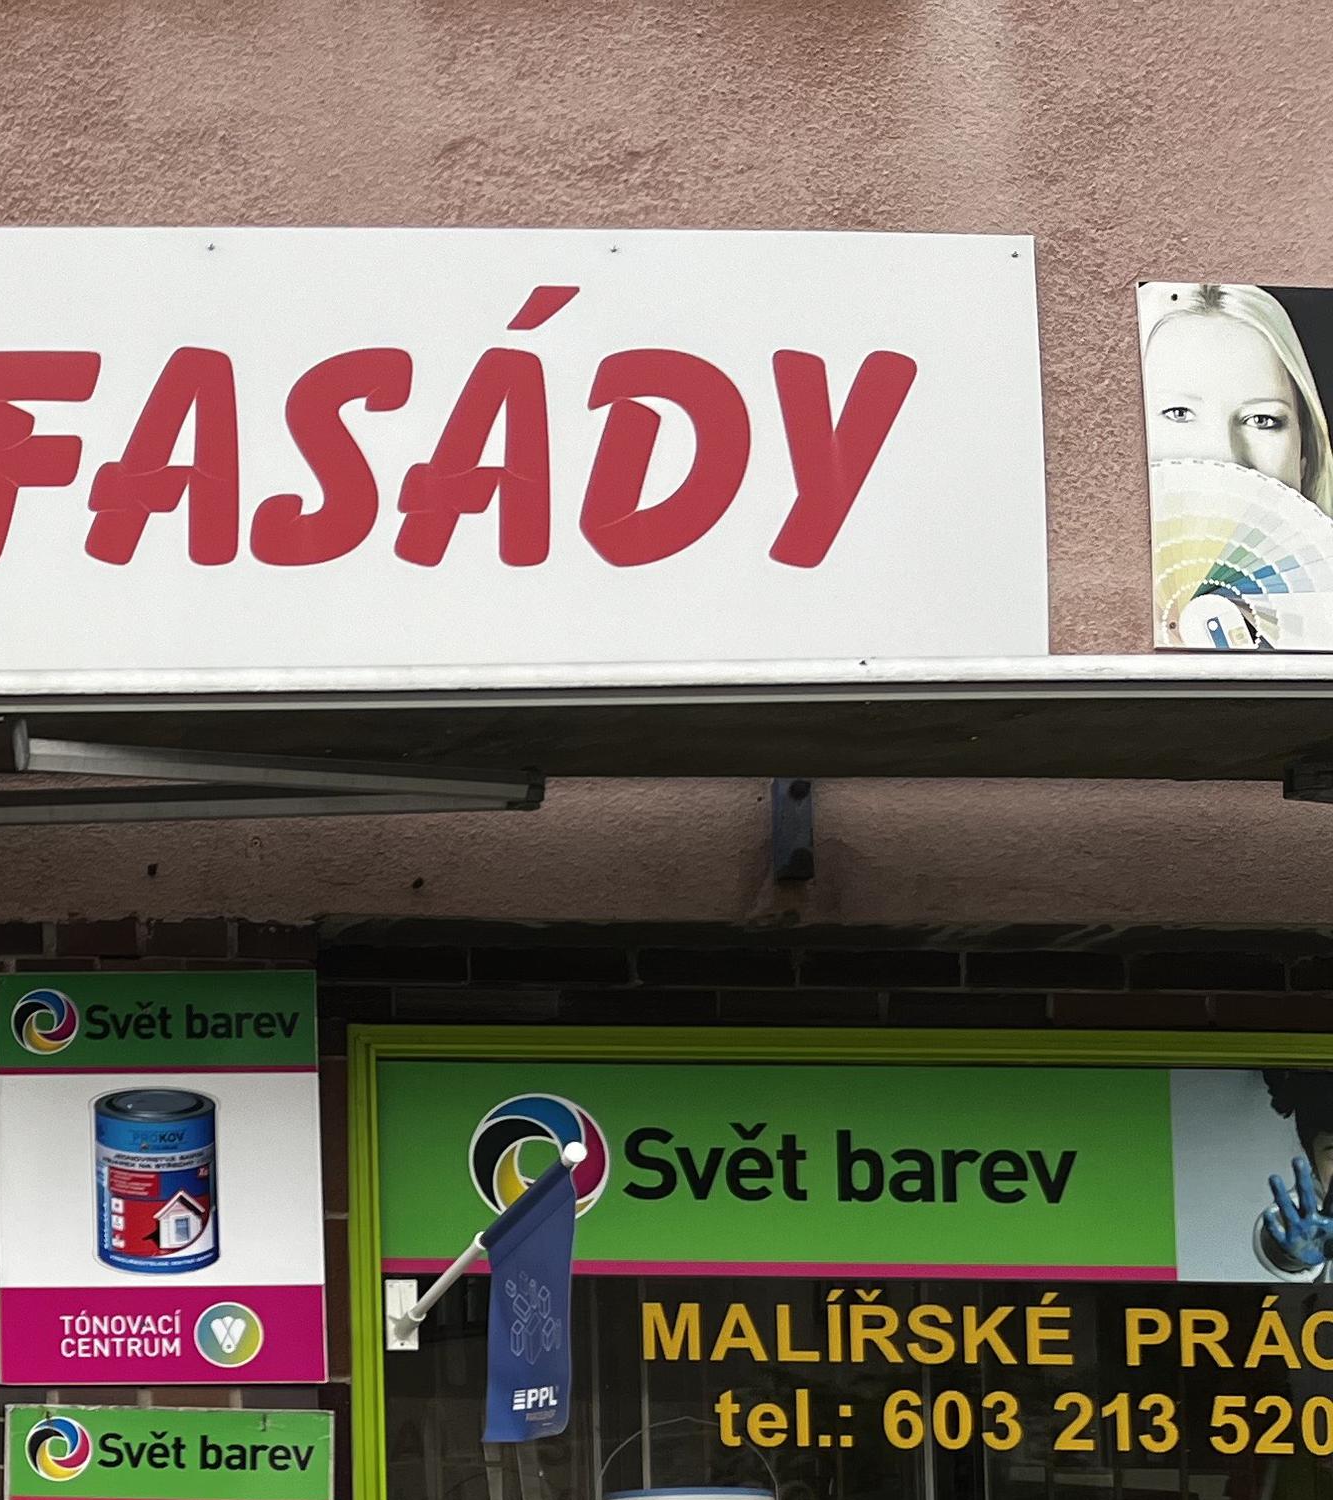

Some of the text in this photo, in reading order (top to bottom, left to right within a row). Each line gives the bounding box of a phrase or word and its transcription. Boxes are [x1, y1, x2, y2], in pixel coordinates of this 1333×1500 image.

[84, 1001, 300, 1041] Svět barev
[621, 1122, 1078, 1204] Svět barev
[59, 1308, 182, 1335] TÓNOVACÍ
[641, 1288, 1075, 1367] MALÍŘSKÉ
[60, 1336, 182, 1358] CENTRUM
[526, 1386, 558, 1408] PPL
[715, 1389, 1333, 1456] tel.: 603 213 520
[97, 1431, 315, 1472] Svět barev
